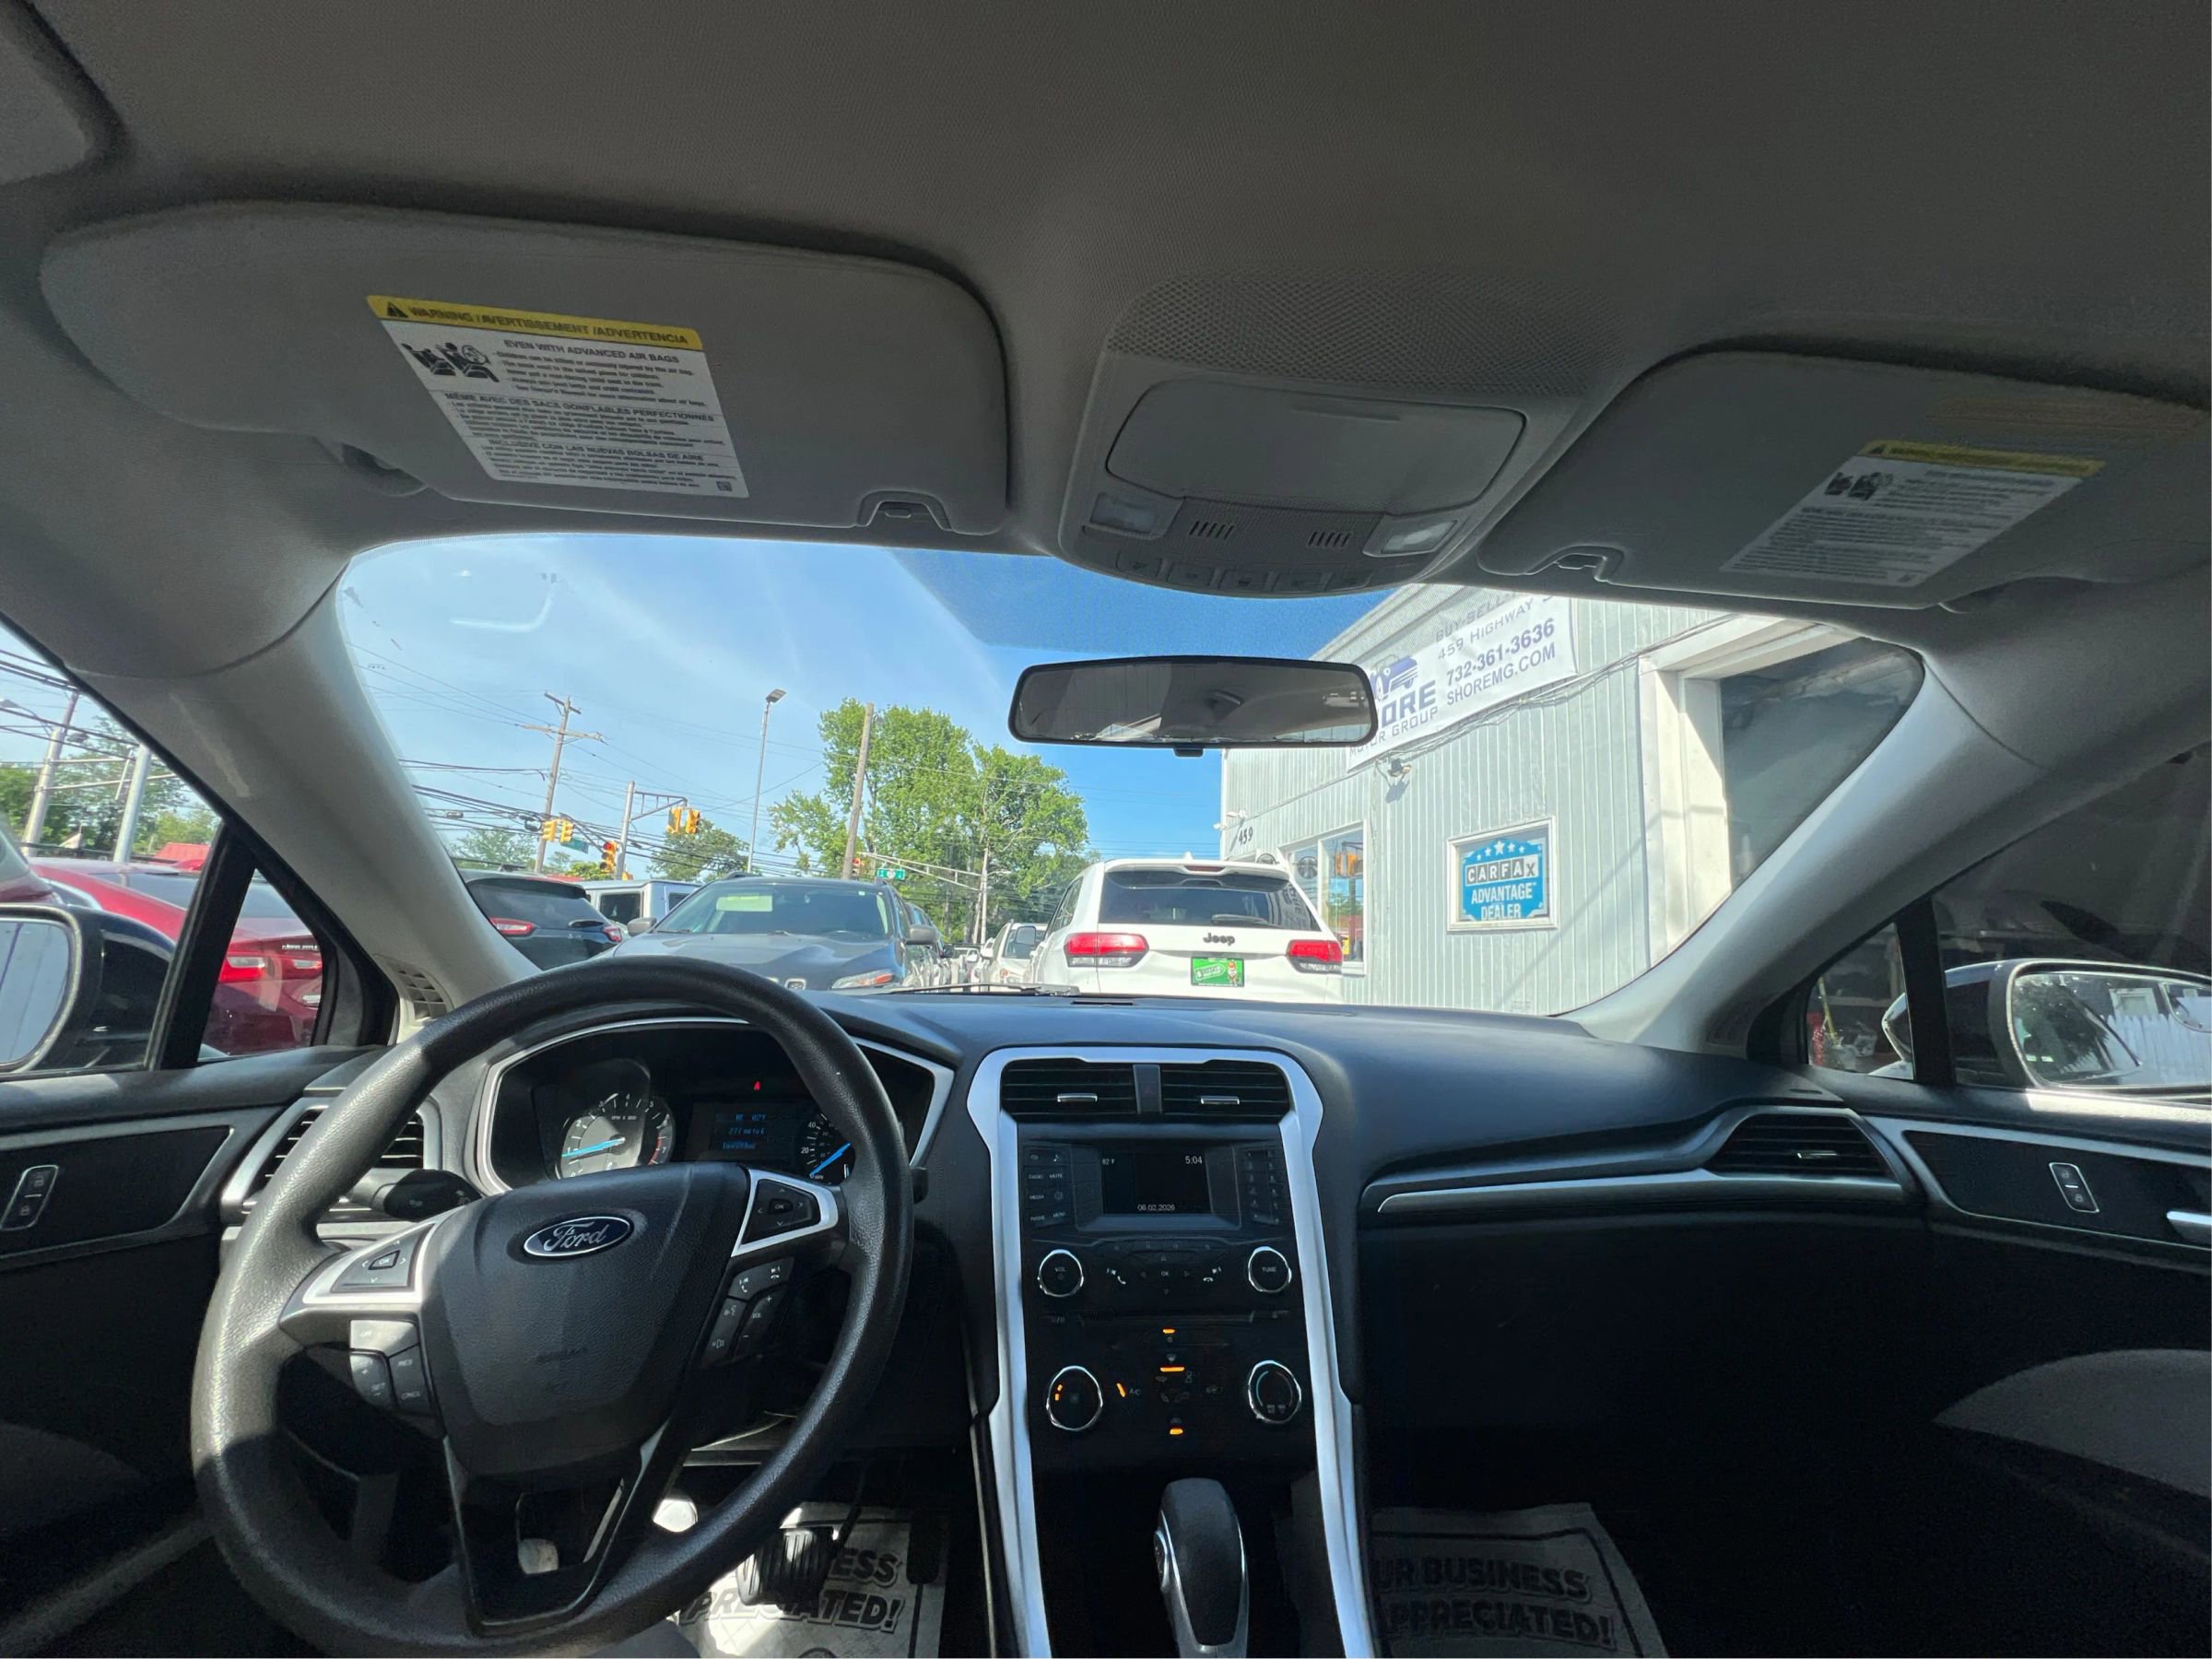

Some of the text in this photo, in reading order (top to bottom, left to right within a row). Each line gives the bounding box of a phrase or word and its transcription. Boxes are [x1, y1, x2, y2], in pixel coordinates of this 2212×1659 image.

[503, 339, 679, 363] EVEN WITH ADVANCED AIR BAGS
[1438, 597, 1533, 659] 459 HIGHWAY
[1446, 618, 1555, 686] 732-361-3636
[1447, 641, 1555, 706] SHOREMG.COM
[1392, 706, 1438, 737] GROUP
[1239, 826, 1253, 845] 459
[1467, 861, 1535, 883] CARFAX
[1471, 883, 1533, 904] ADVANTAGE
[1481, 903, 1521, 921] DEALER
[1203, 932, 1235, 947] Jeep
[1184, 1155, 1203, 1165] 5:04
[543, 1221, 609, 1252] Ford
